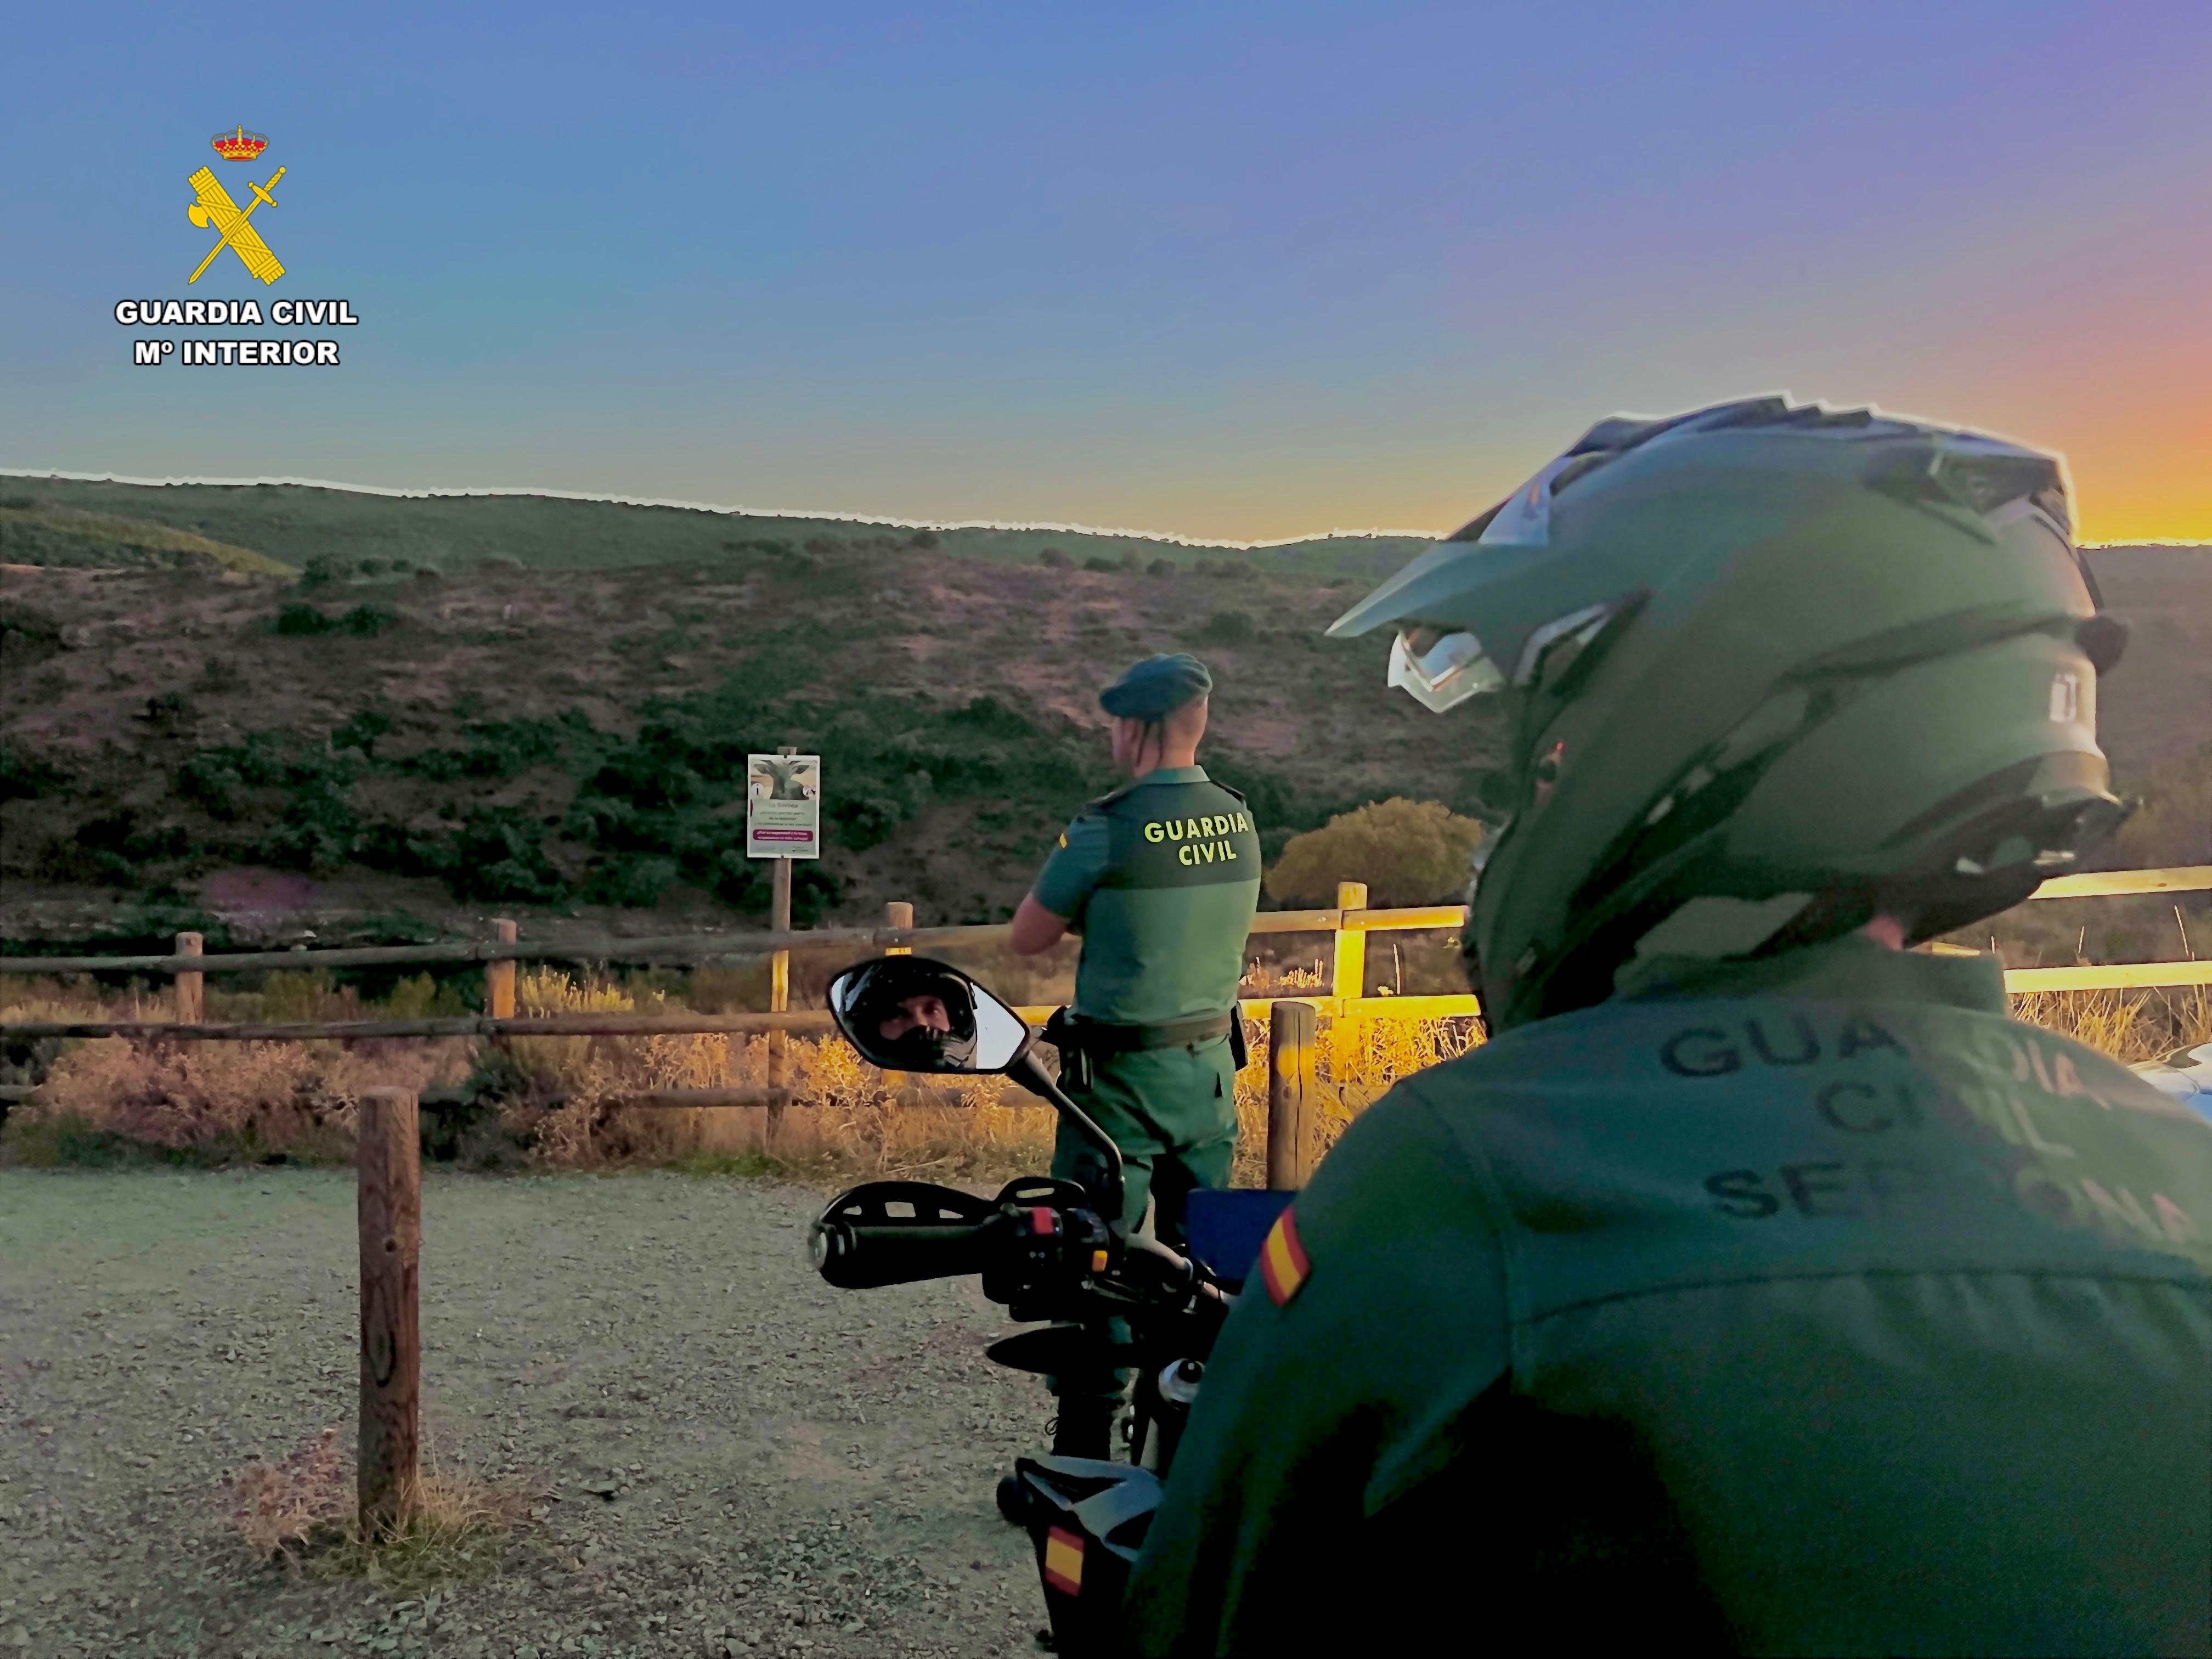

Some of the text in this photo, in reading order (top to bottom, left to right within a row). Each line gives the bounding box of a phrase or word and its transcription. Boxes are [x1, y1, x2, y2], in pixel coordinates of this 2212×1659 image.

[1144, 812, 1249, 843] GUARDIA
[1179, 840, 1237, 866] CIVIL
[1658, 1013, 2111, 1110] GUADIA
[1815, 1079, 2076, 1158] CIIL
